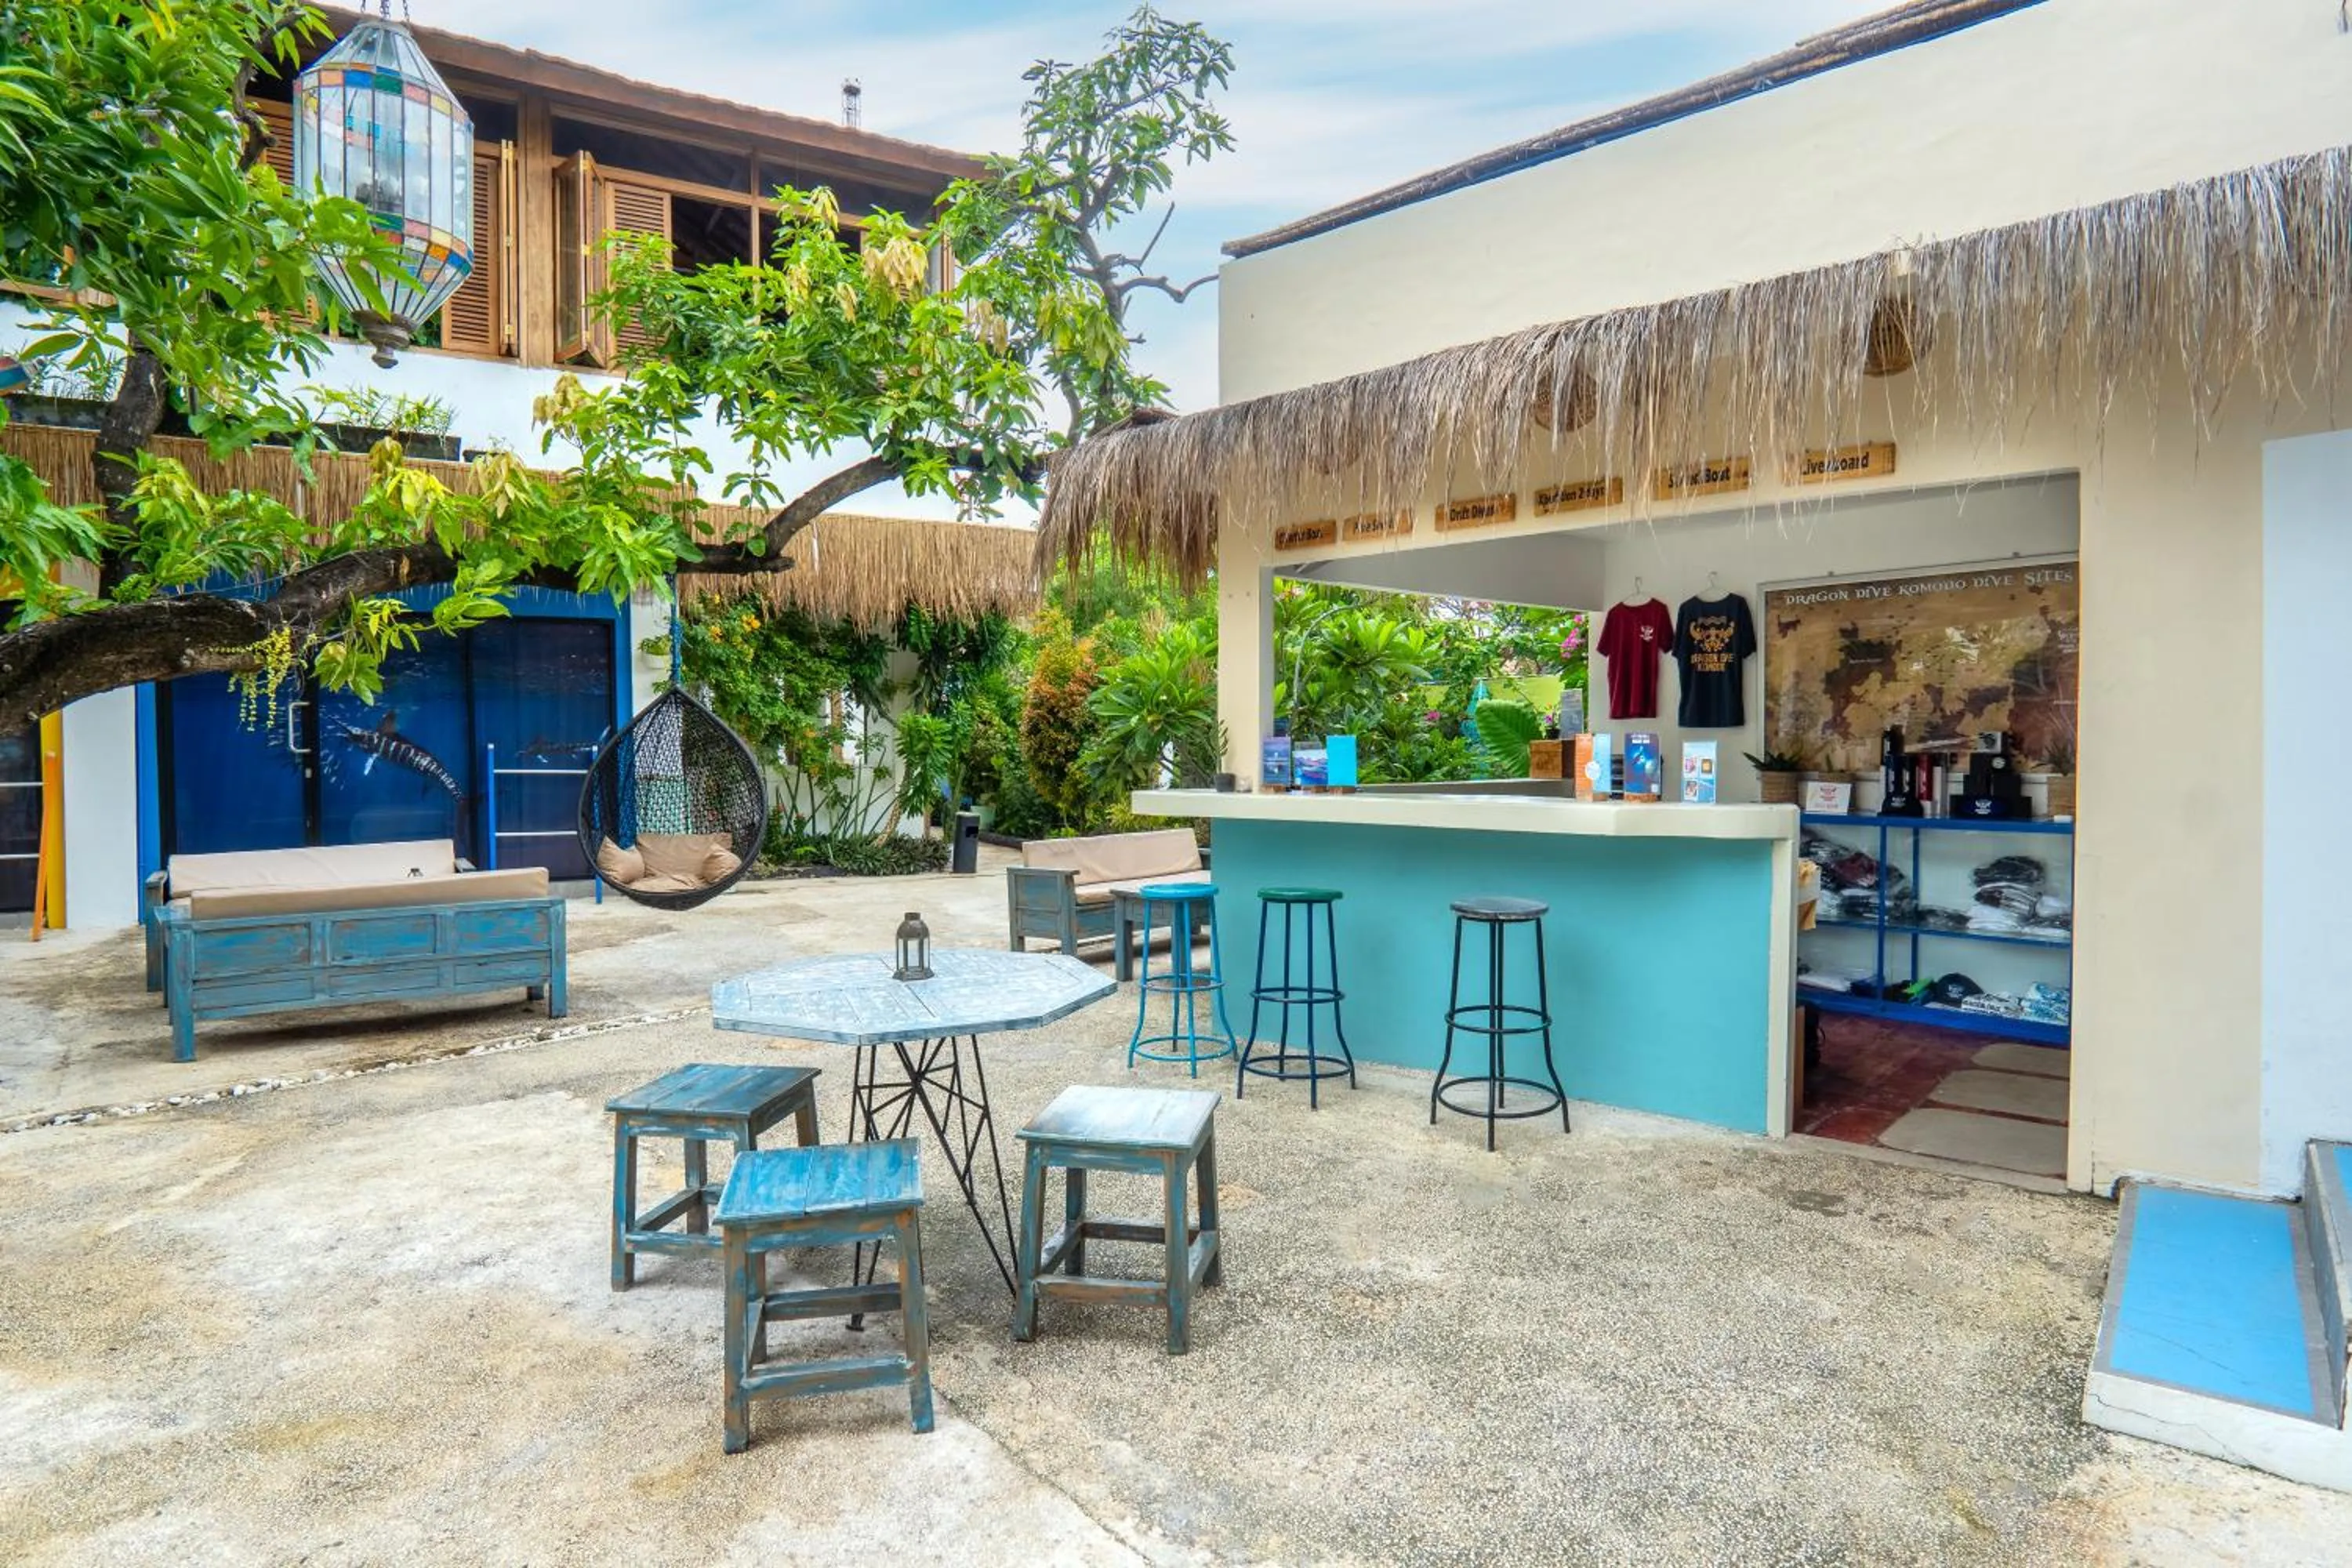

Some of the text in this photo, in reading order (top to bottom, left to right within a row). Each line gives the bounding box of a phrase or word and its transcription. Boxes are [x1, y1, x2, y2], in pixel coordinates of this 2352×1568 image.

[1785, 569, 2074, 604] DRAGON DIVE KOMODO DIVE SITES
